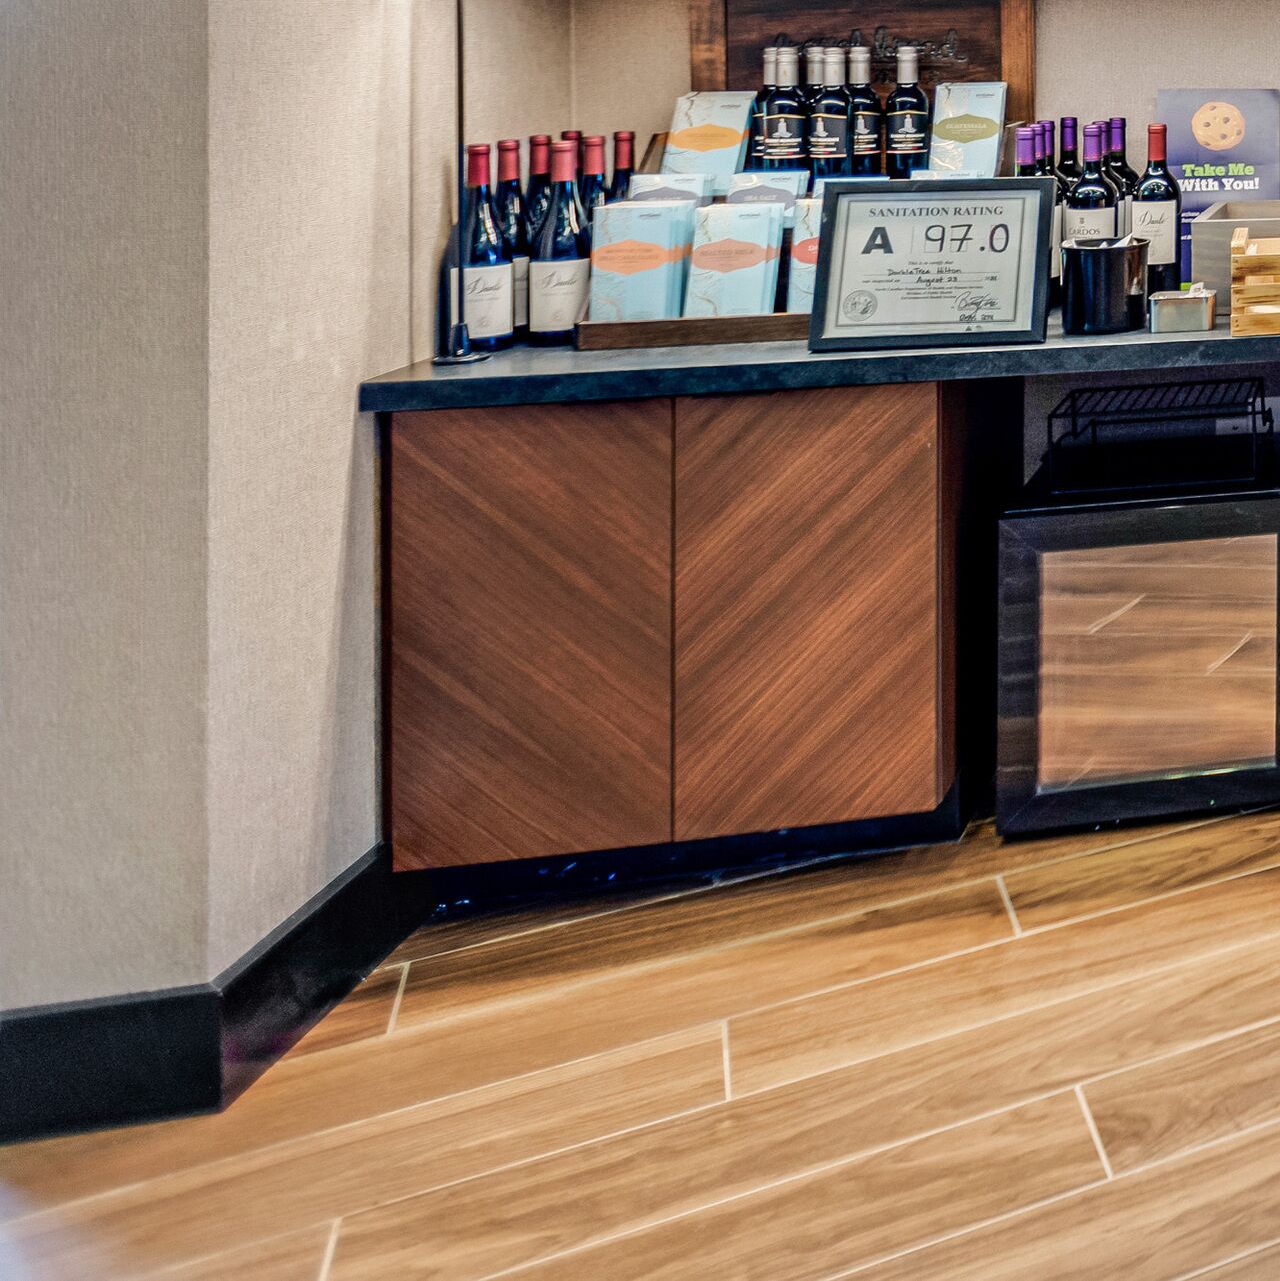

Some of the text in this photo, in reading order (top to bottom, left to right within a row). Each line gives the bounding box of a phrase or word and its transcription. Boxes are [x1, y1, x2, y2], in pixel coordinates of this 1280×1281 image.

[1182, 163, 1255, 177] Take Me
[1178, 177, 1259, 192] With You!
[869, 205, 1004, 218] SANITATION RATING
[861, 226, 894, 255] A
[924, 223, 1010, 254] 97.0
